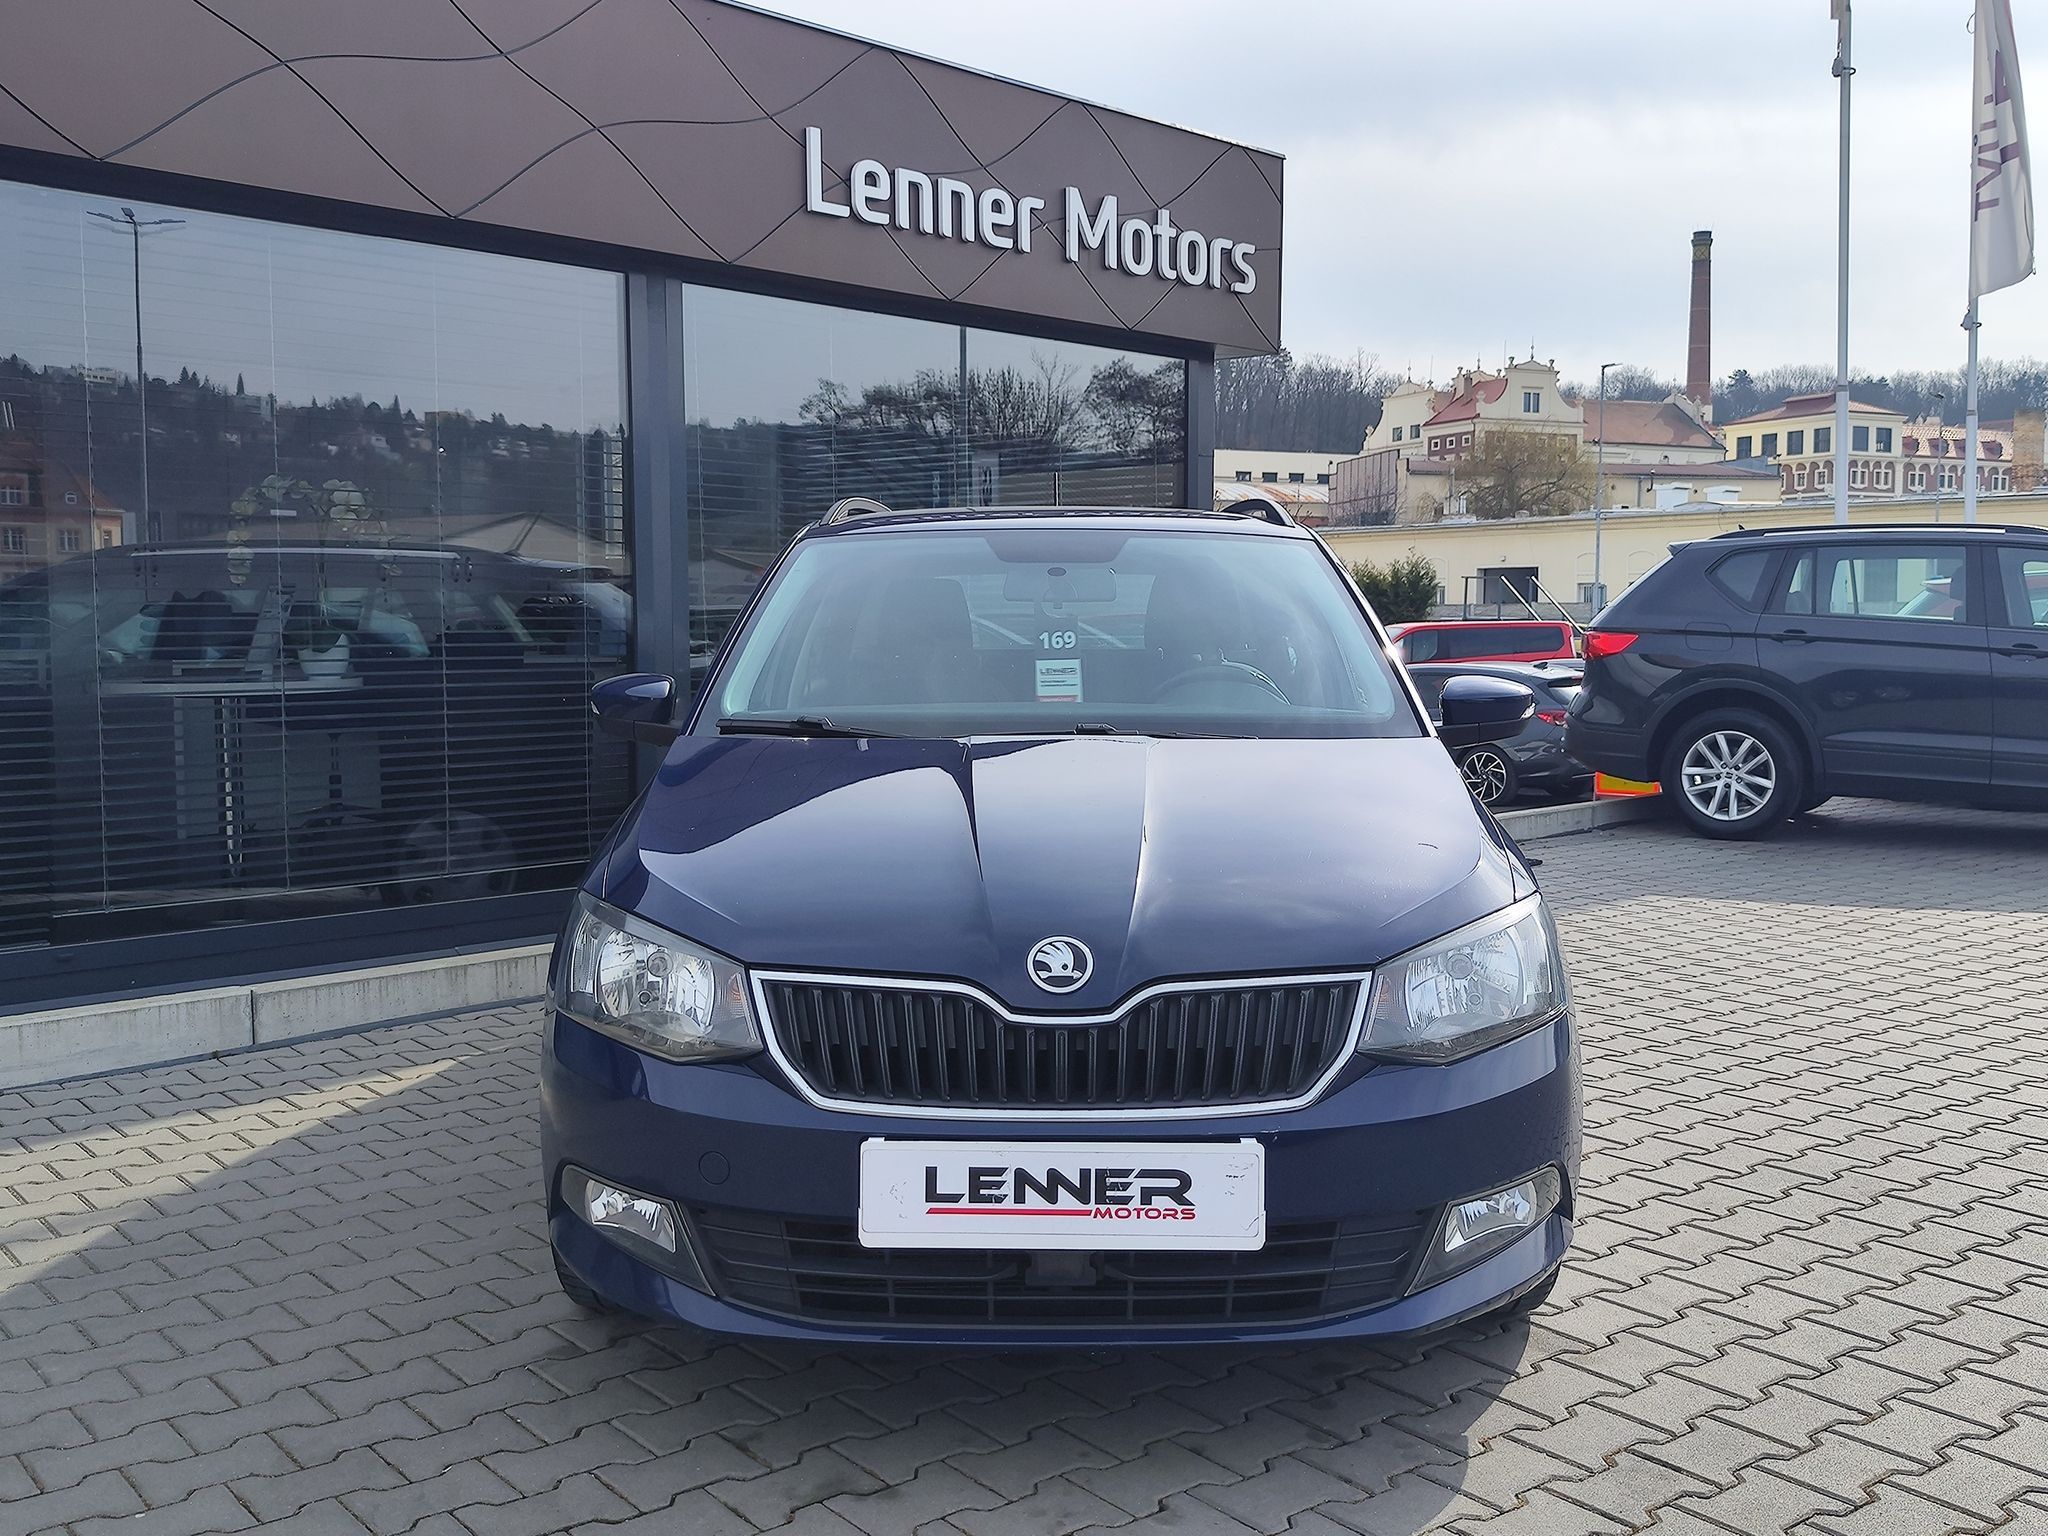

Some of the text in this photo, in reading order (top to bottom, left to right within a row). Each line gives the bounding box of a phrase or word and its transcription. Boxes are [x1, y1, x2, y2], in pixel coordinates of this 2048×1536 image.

[805, 126, 1257, 294] Lenner Motors
[1039, 631, 1077, 649] 169
[925, 1166, 1196, 1206] LENNER
[1093, 1207, 1196, 1220] MOTORS
